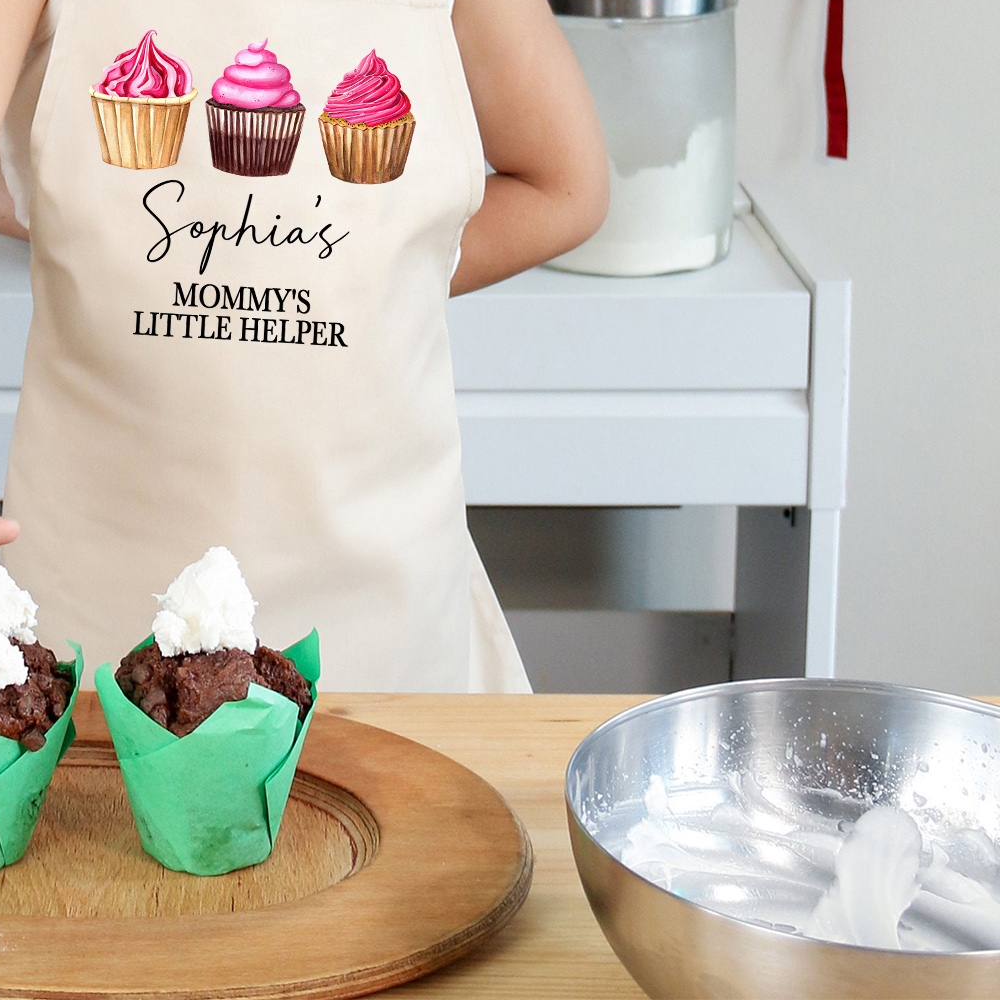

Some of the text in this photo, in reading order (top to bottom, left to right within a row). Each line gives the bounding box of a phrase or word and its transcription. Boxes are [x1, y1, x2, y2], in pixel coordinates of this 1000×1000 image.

[142, 179, 350, 276] Sophia's
[172, 281, 312, 315] MOMMY'S
[132, 310, 349, 348] LITTLE HELPER
